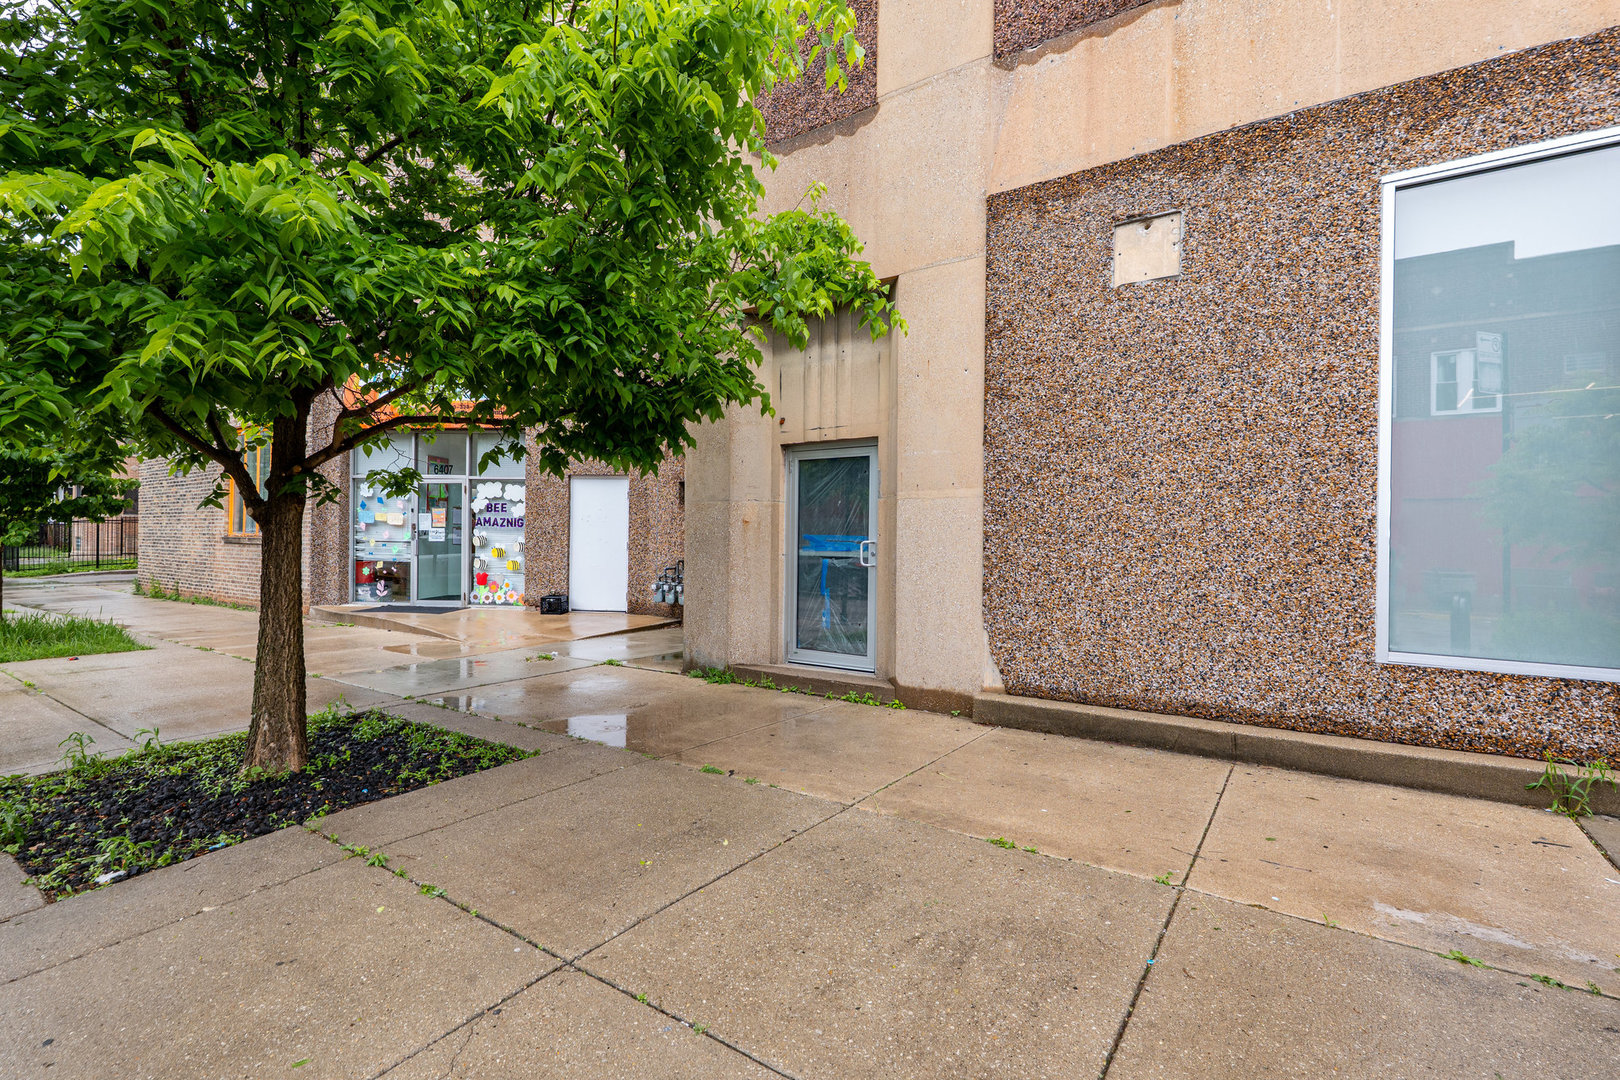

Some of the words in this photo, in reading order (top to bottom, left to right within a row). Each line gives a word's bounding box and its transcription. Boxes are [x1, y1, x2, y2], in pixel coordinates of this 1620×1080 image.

[434, 464, 453, 474] 6407
[486, 503, 507, 513] BEE
[475, 517, 524, 527] AMAZNIG
